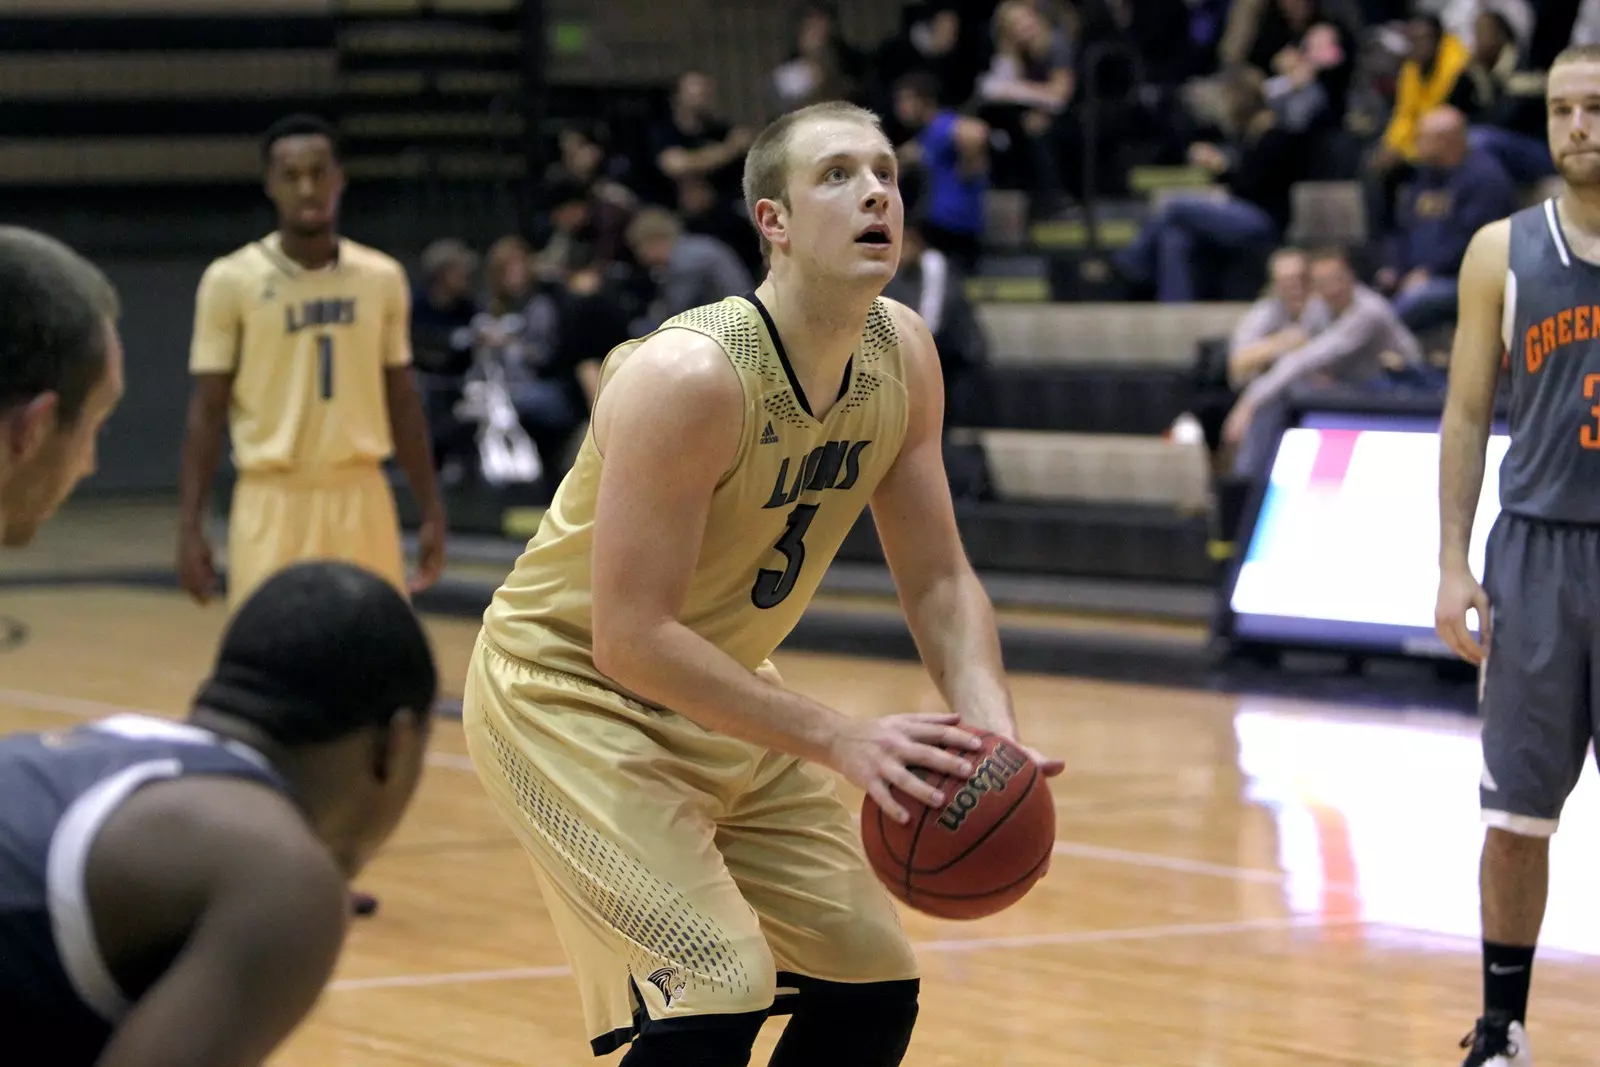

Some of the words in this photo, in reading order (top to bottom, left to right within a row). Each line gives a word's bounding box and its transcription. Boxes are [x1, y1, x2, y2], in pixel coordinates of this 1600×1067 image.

[285, 298, 356, 333] LIONS
[316, 335, 333, 400] 1
[761, 440, 873, 508] LIONS
[751, 503, 822, 609] 3
[936, 742, 1029, 832] Wilson
